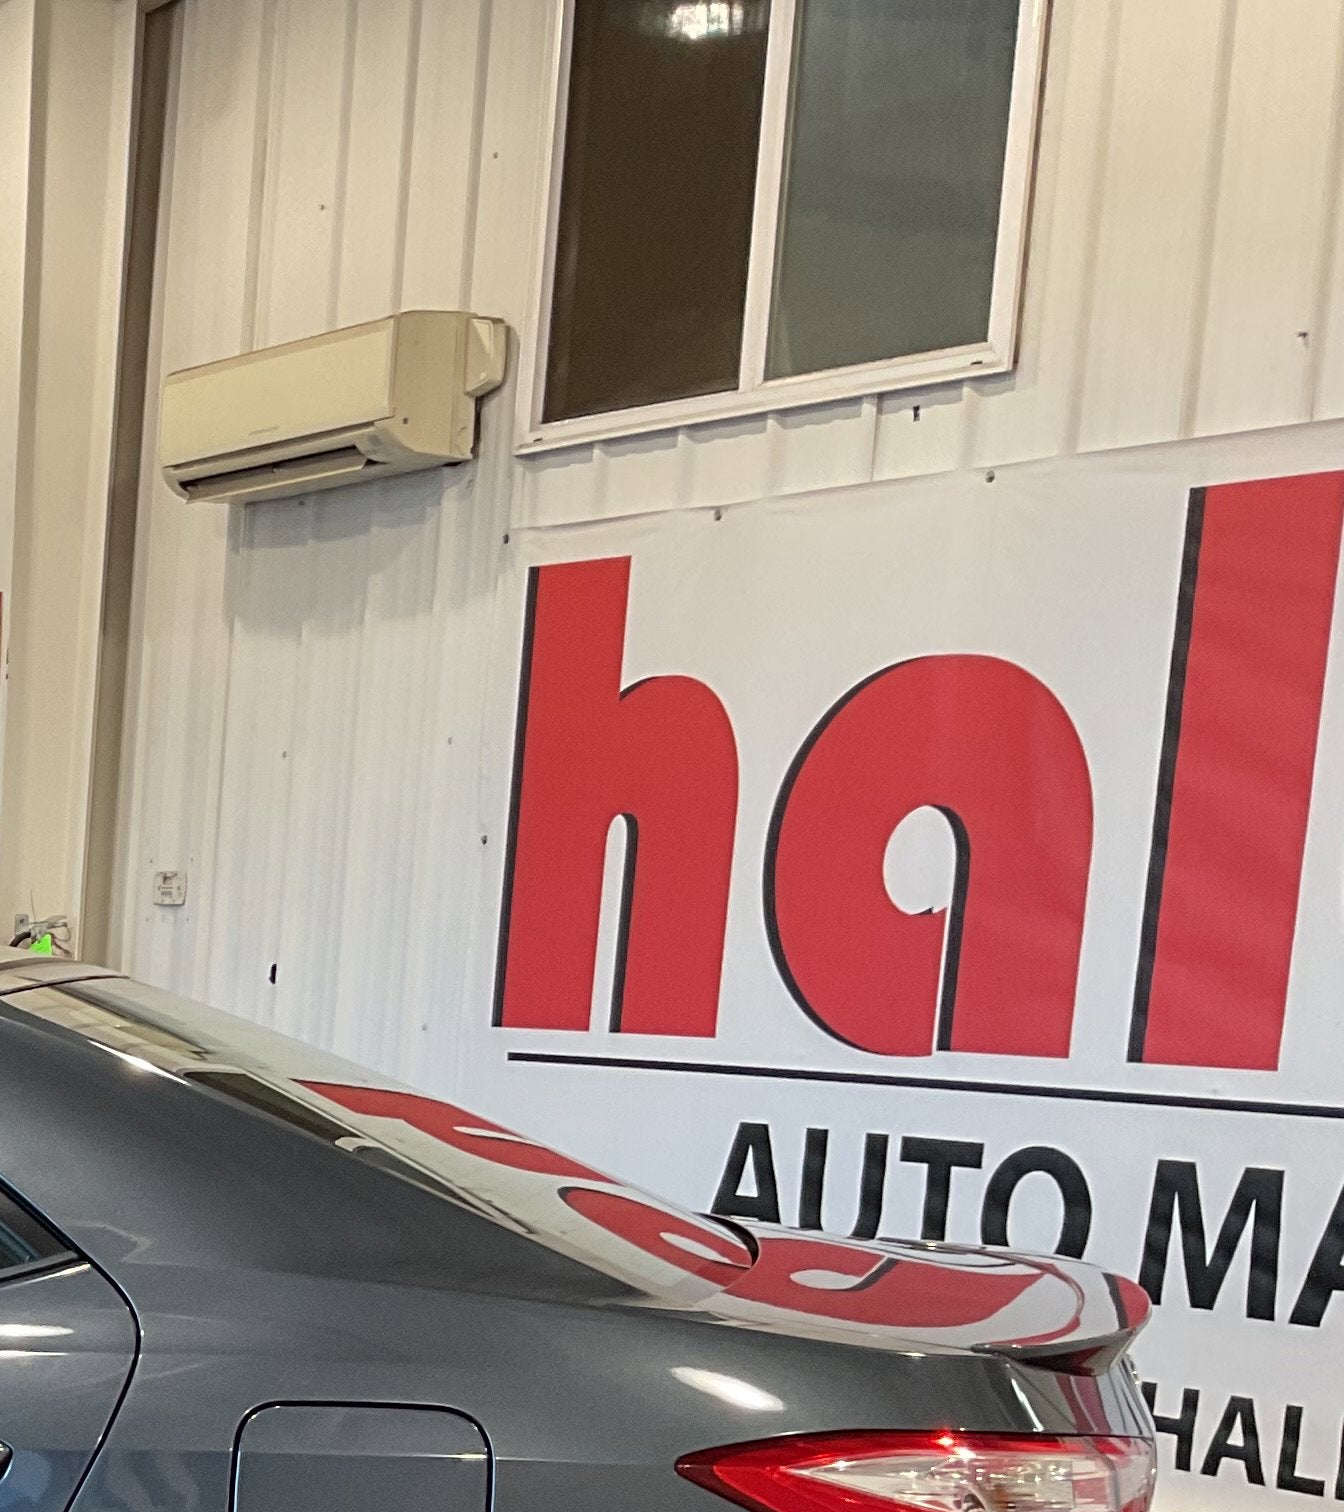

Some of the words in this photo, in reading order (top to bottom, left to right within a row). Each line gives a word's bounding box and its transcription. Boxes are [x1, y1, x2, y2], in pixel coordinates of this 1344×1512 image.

[492, 469, 1344, 1072] hal
[710, 1121, 1093, 1262] AUTO
[1140, 1381, 1344, 1503] HAL
